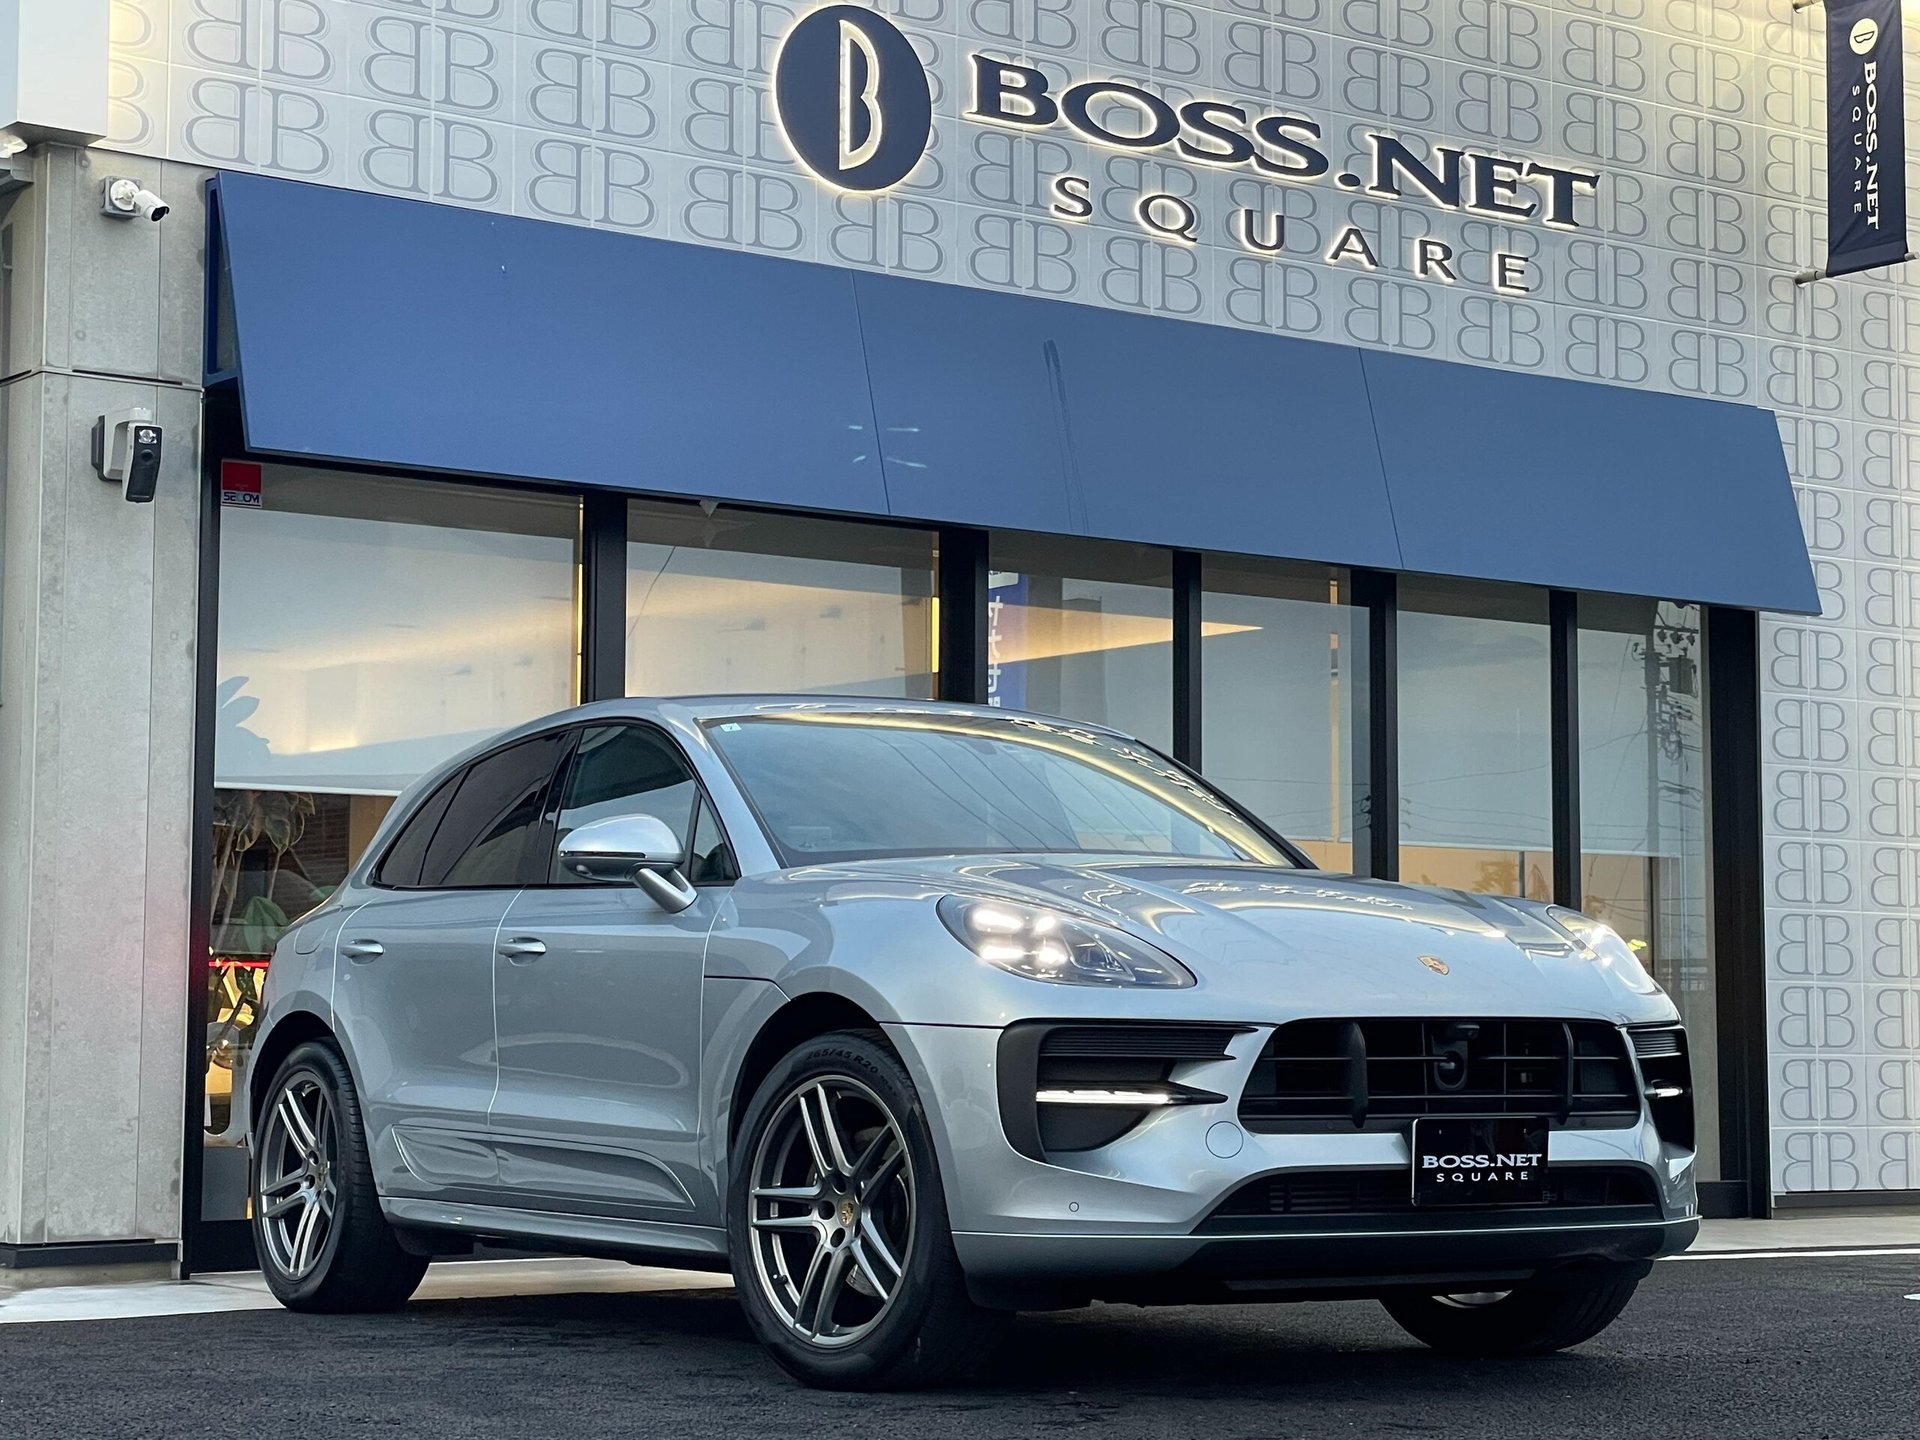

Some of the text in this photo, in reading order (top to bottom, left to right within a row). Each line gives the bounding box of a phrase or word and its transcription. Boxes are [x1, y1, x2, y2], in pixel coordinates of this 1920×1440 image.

[966, 53, 1600, 230] BOSS.NET
[1852, 85, 1862, 213] SQUARE
[1864, 61, 1879, 230] BOSS.NET
[1050, 175, 1530, 292] SQUARE
[1422, 1153, 1542, 1168] BOSS.NET
[1436, 1171, 1528, 1183] SQUARE
